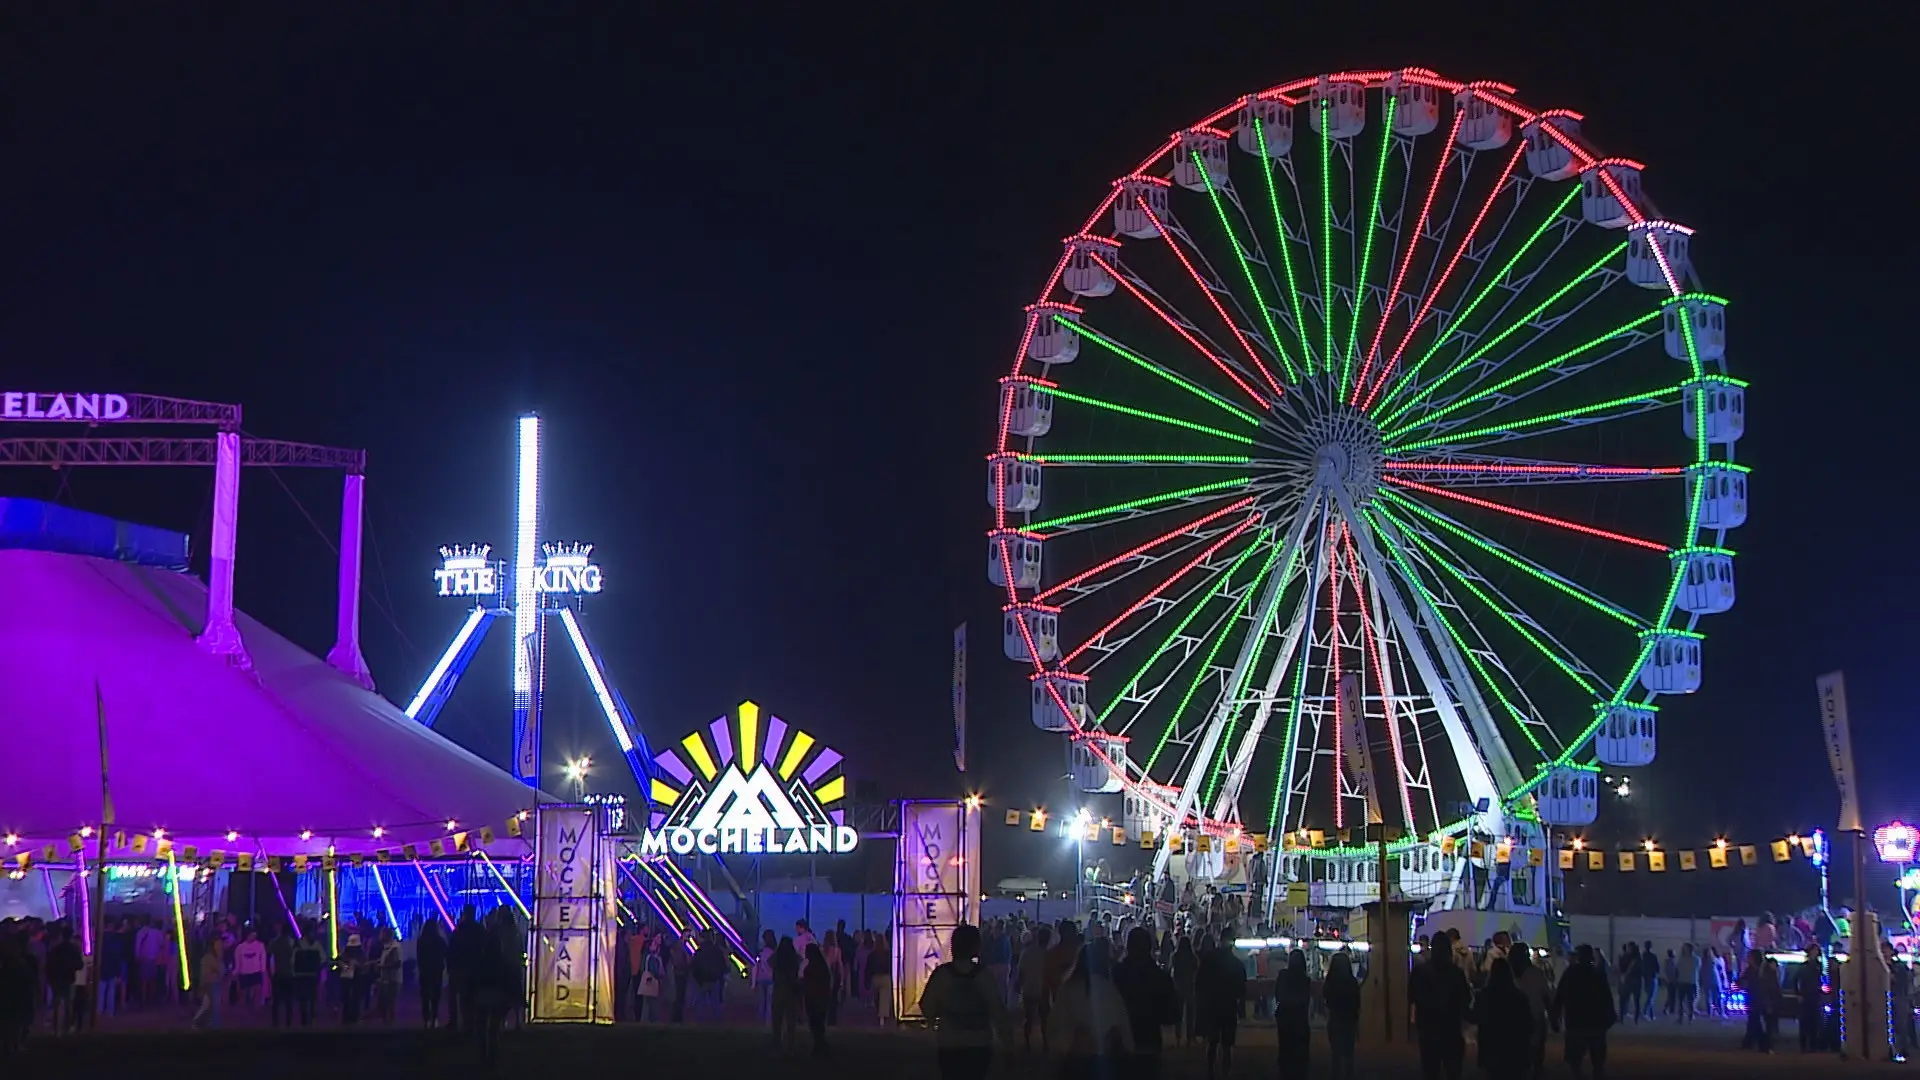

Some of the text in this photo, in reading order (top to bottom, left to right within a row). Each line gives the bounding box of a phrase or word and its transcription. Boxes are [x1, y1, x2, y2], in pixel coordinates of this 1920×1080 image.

[4, 391, 128, 420] ELAND
[434, 564, 603, 596] THE KING
[640, 825, 859, 855] MOCHELAND
[556, 827, 577, 1001] MOCHELAND
[923, 823, 942, 979] MOCHELAN
